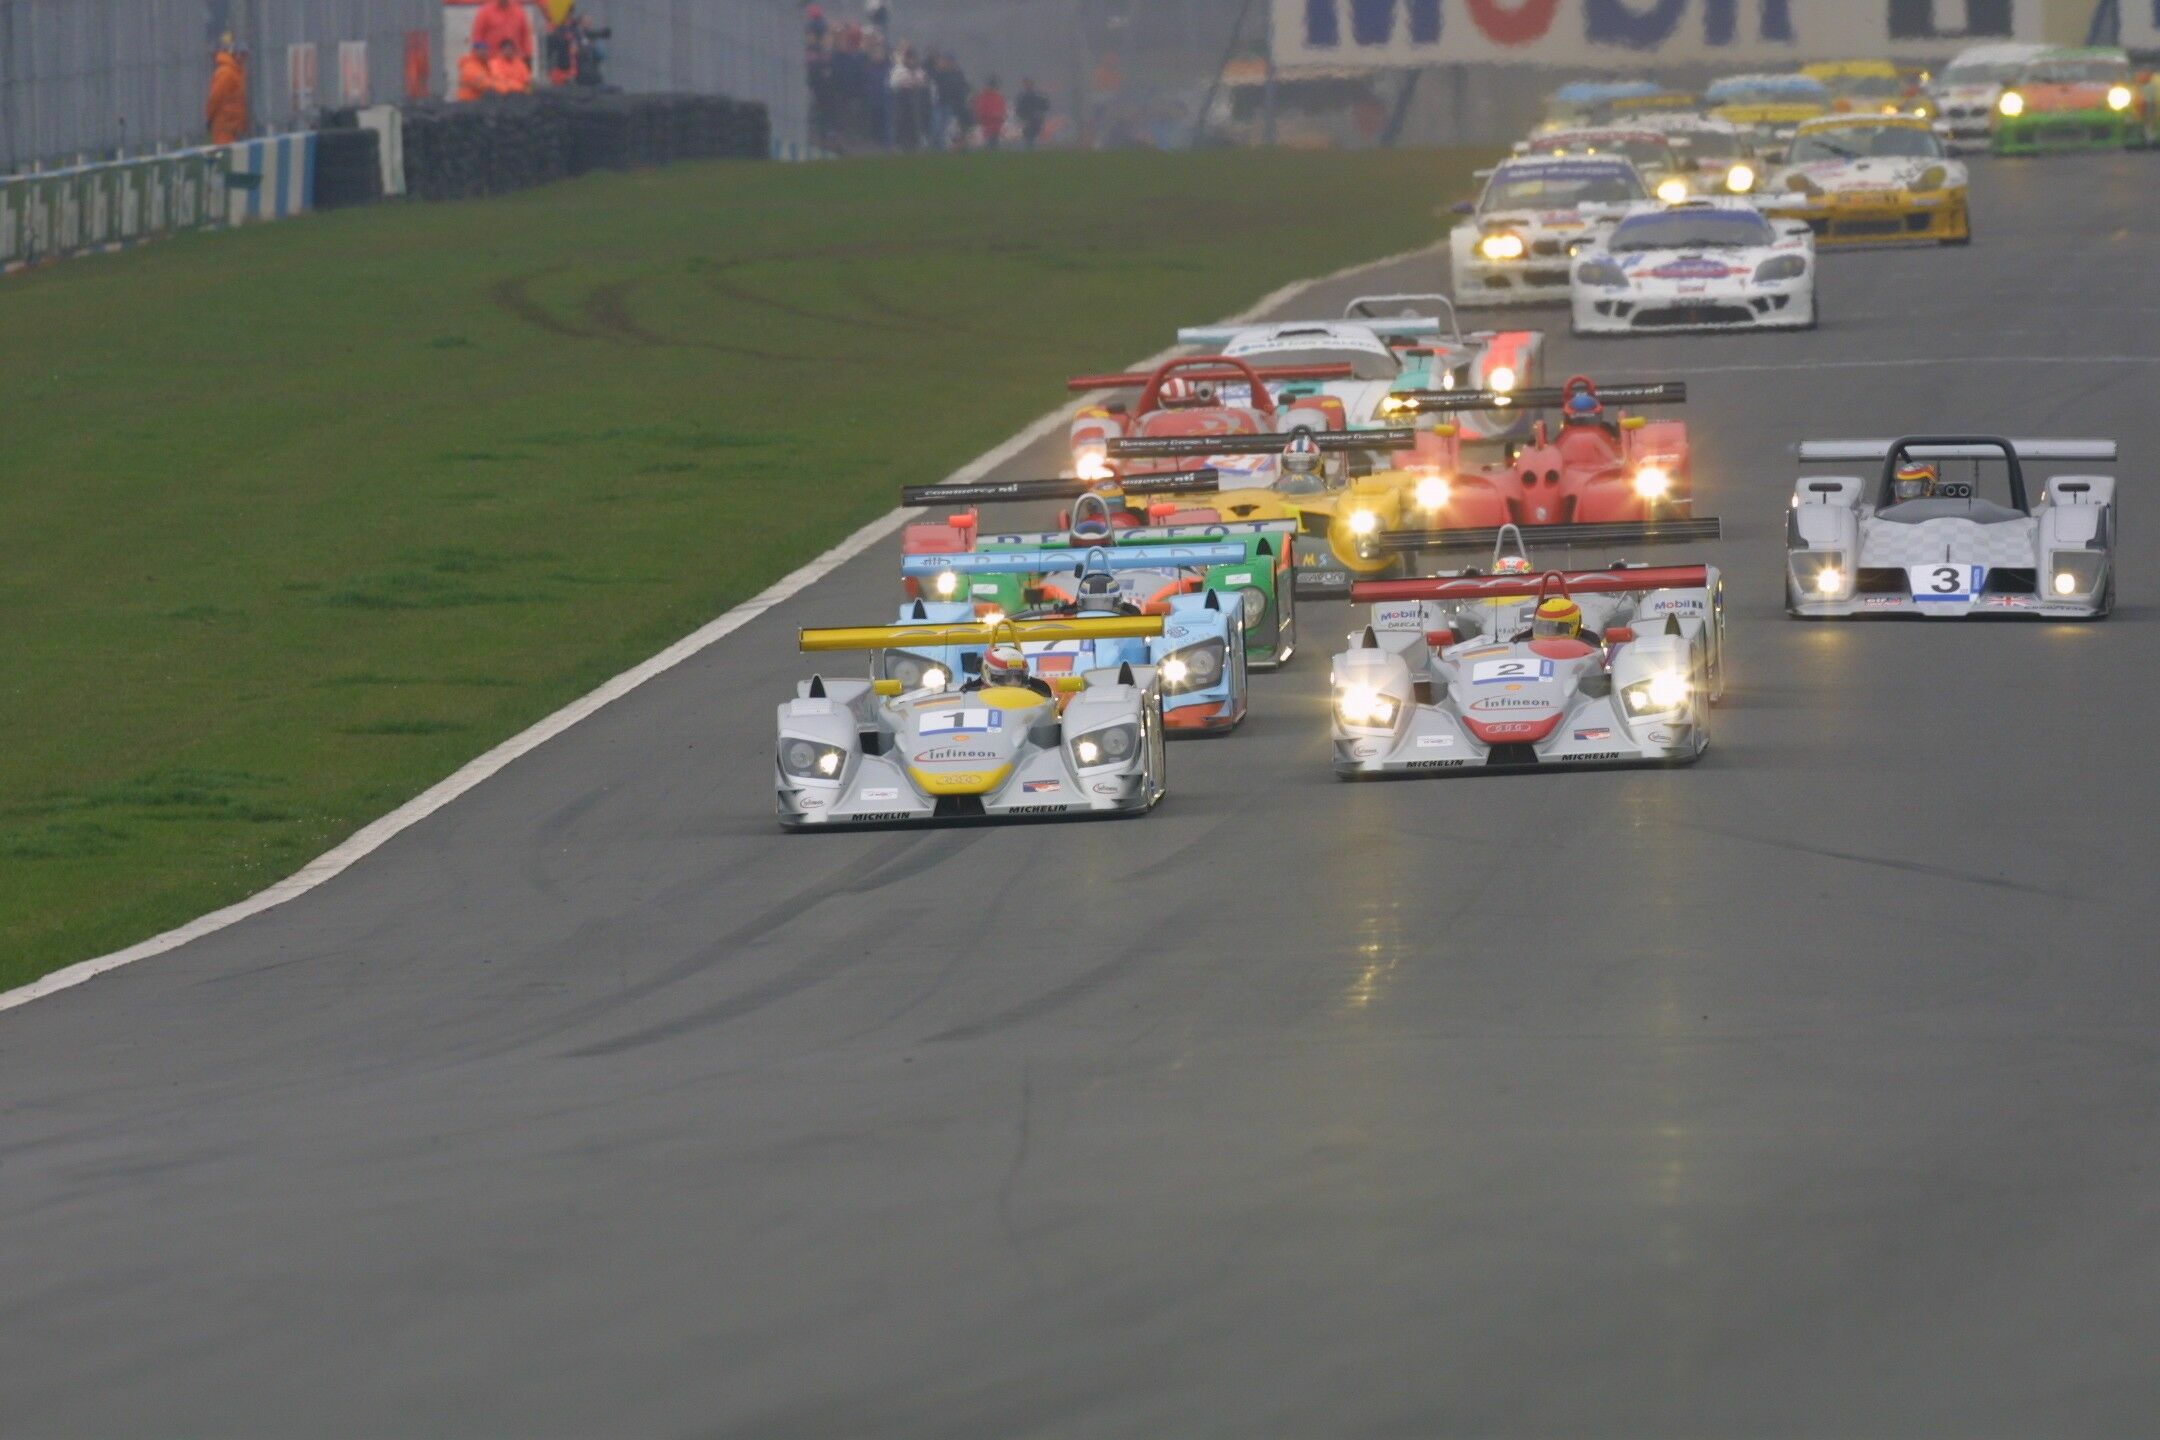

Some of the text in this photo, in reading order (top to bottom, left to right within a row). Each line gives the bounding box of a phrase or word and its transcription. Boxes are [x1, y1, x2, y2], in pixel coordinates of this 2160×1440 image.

[1930, 567, 1961, 594] 3
[1497, 663, 1525, 676] 2
[942, 712, 965, 728] 1
[1560, 752, 1620, 761] MICHELIN
[1405, 760, 1465, 769] MICHELIN
[1008, 804, 1069, 814] MICHELIN
[850, 812, 912, 822] MICHELIN
